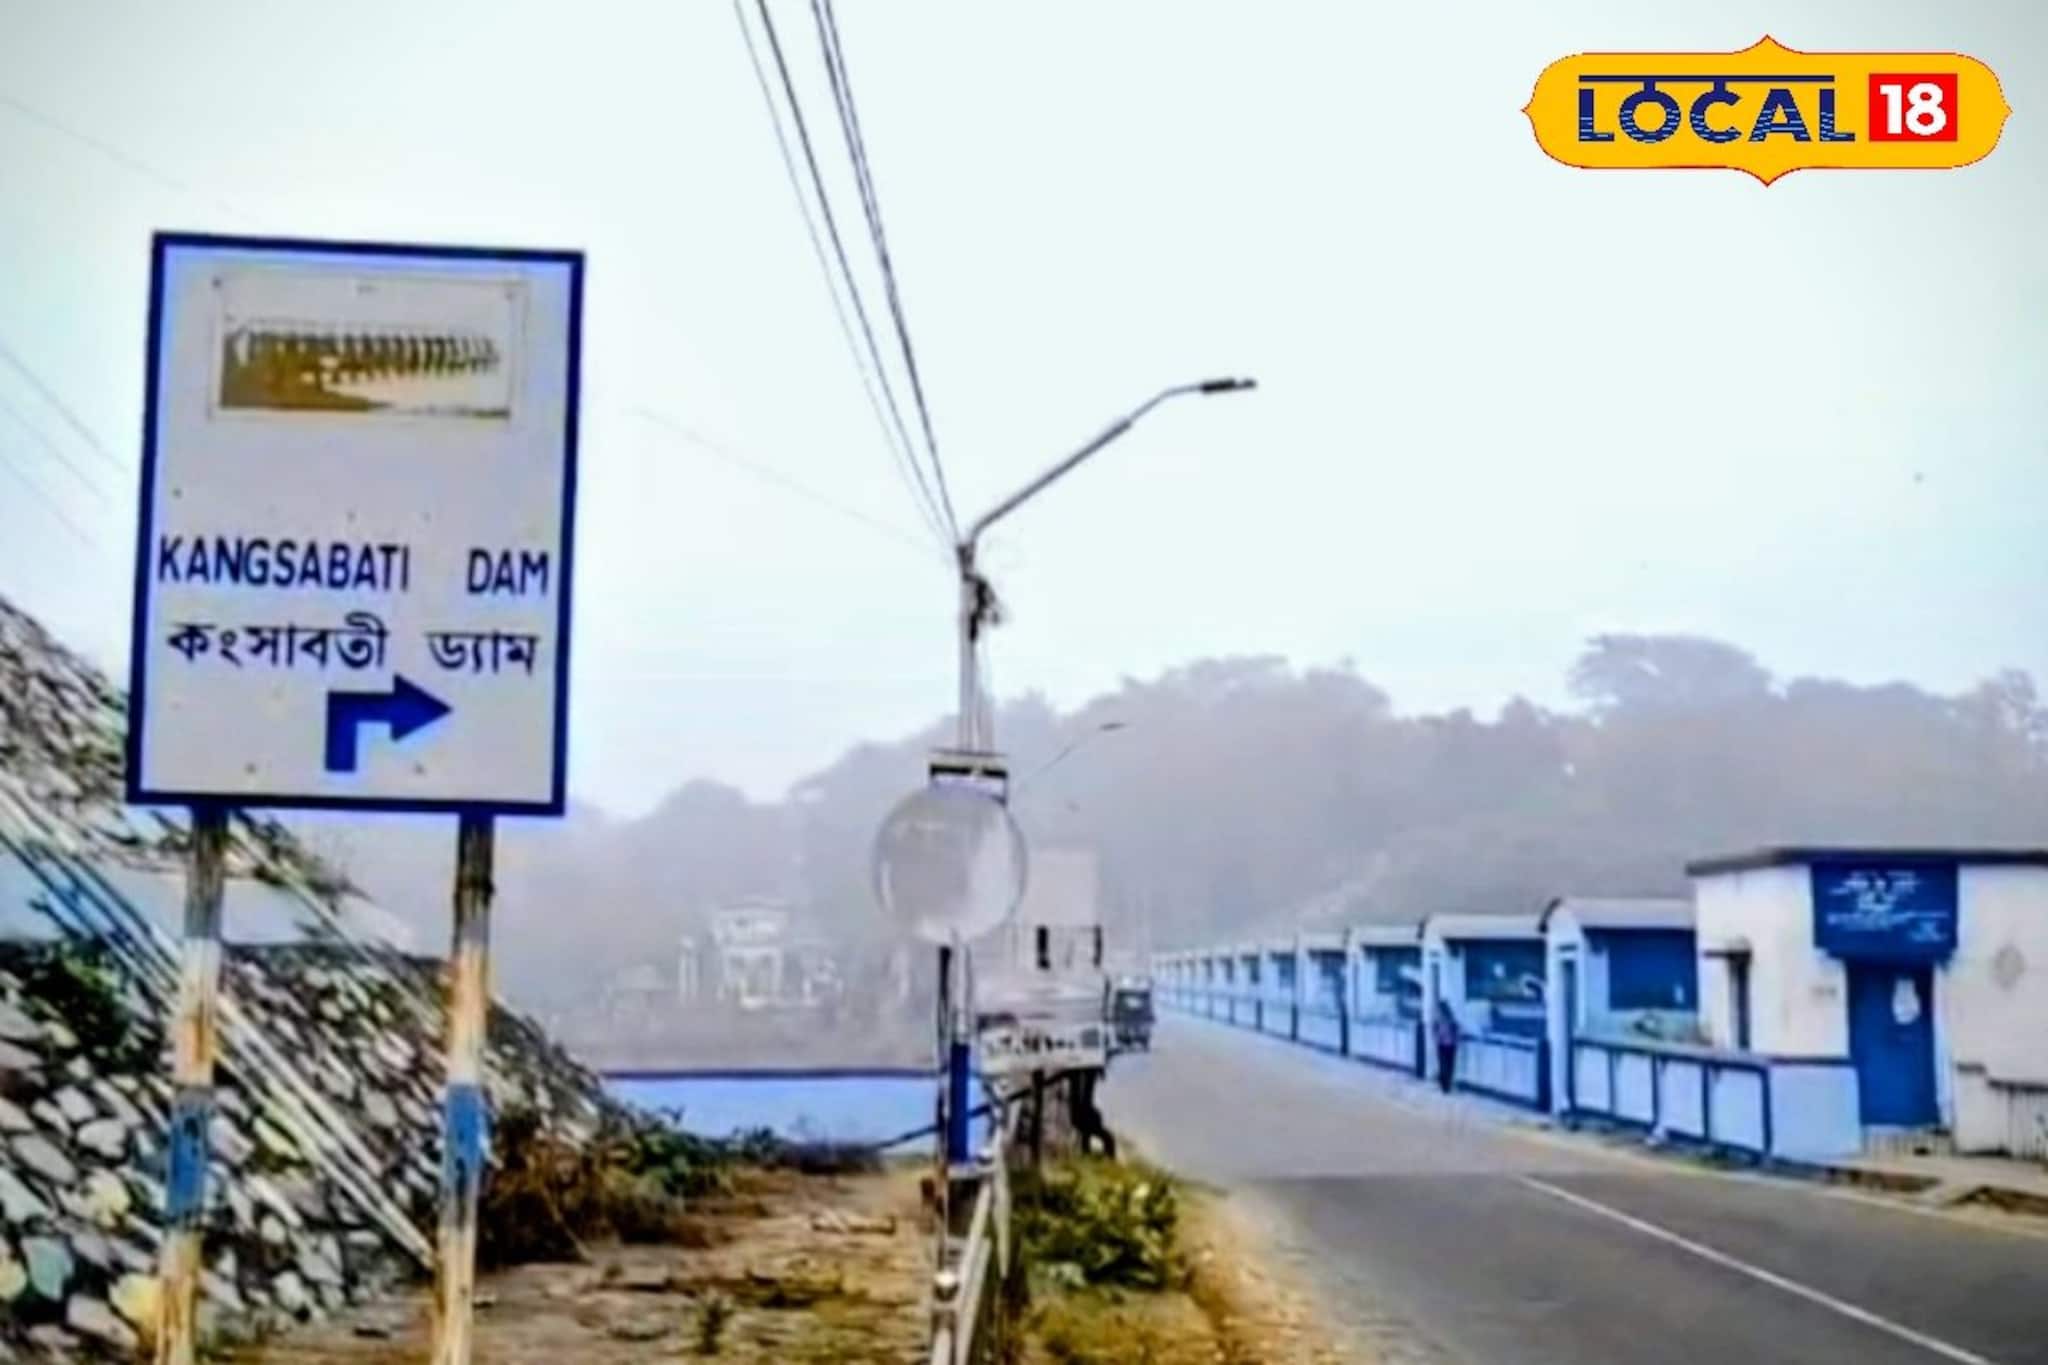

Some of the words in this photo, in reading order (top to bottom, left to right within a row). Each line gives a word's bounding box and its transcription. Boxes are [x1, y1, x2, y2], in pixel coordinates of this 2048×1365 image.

[159, 535, 409, 591] KANGSABATI
[467, 548, 550, 595] DAM
[167, 611, 389, 669] কংসাবতী
[424, 629, 539, 675] ড্যাম
